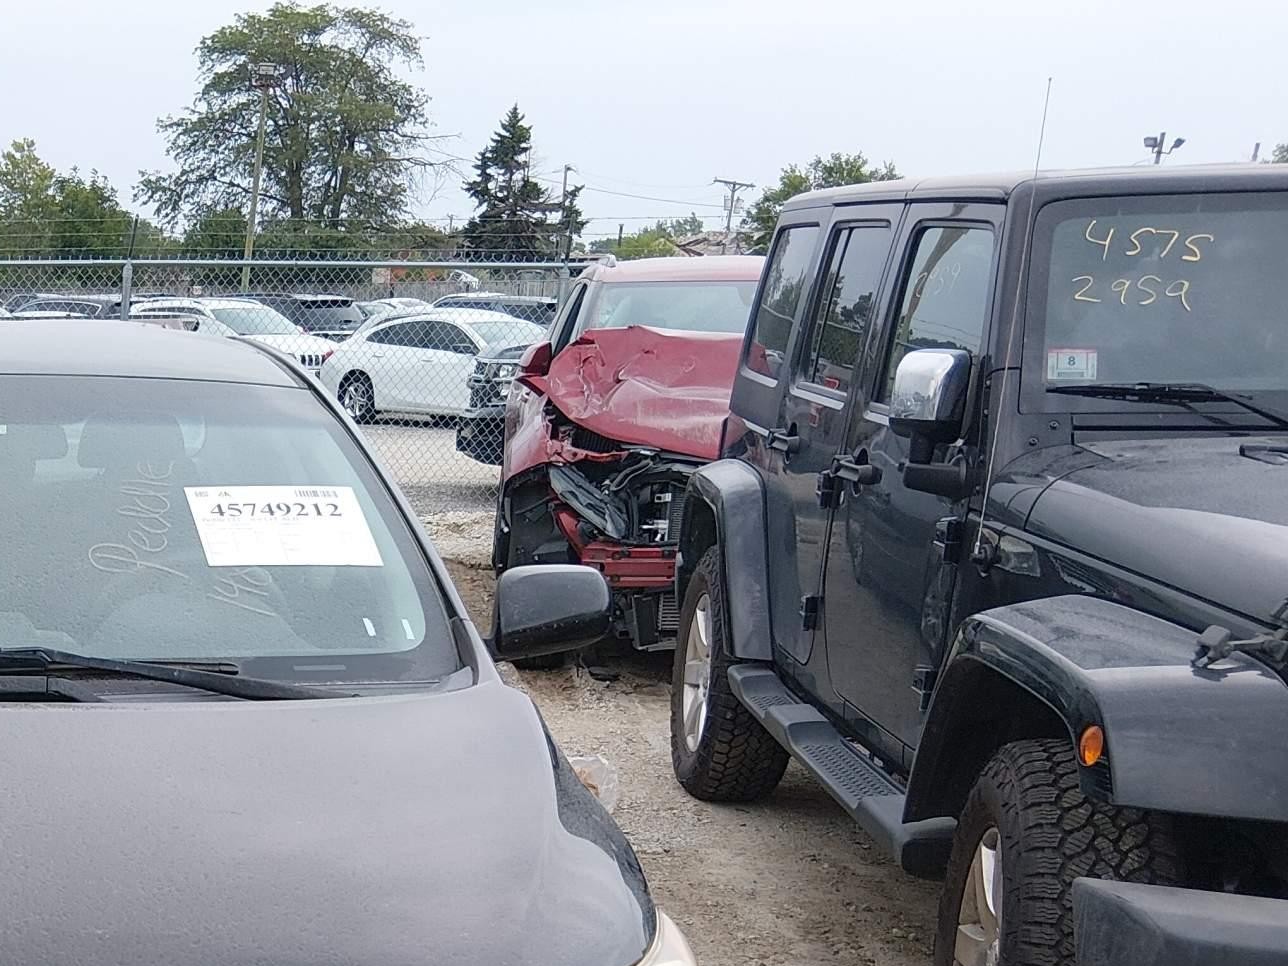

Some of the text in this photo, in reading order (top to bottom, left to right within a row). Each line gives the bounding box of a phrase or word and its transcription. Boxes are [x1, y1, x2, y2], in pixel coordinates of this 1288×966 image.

[1085, 219, 1215, 262] 4575
[1071, 274, 1192, 312] 2959
[1067, 355, 1076, 367] 8
[210, 502, 343, 517] 45749212
